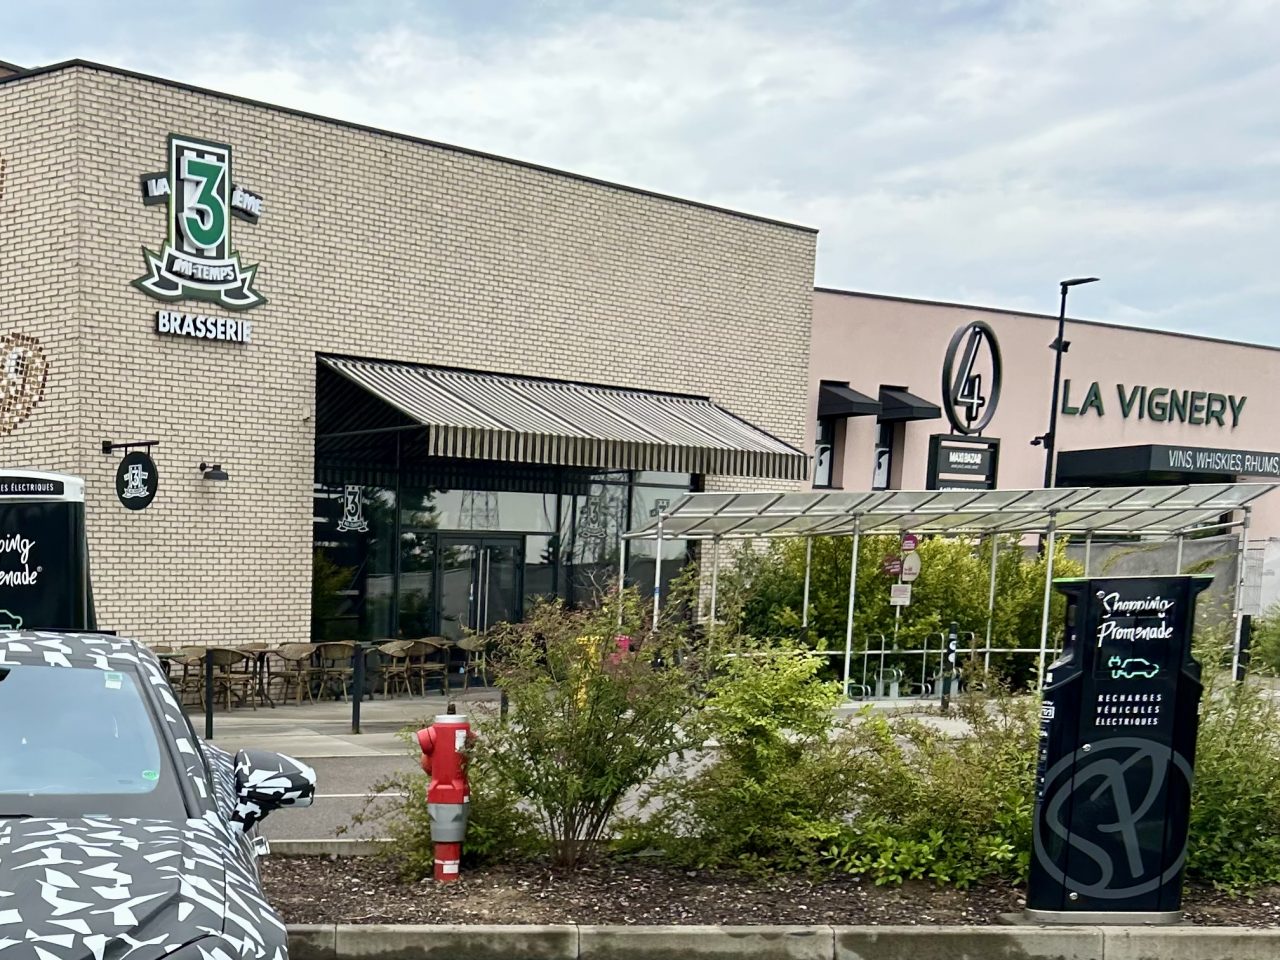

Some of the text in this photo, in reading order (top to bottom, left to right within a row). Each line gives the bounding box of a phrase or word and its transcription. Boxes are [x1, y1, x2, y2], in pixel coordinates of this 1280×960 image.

[147, 178, 171, 197] LA
[179, 156, 226, 249] 3
[172, 258, 235, 281] MI-TEMPS
[157, 311, 252, 343] BRASSERIE
[954, 326, 985, 420] 4
[1061, 379, 1247, 428] LA VIGNERY
[1169, 450, 1280, 476] VINS, WHISKIES, RHUMS,
[10, 481, 54, 492] ÉLECTRIQUES
[1097, 620, 1174, 648] Promenade
[1096, 704, 1160, 714] VÉHICULES
[1097, 694, 1162, 702] RECHARGES
[1095, 717, 1159, 726] ÉLECTRIQUES
